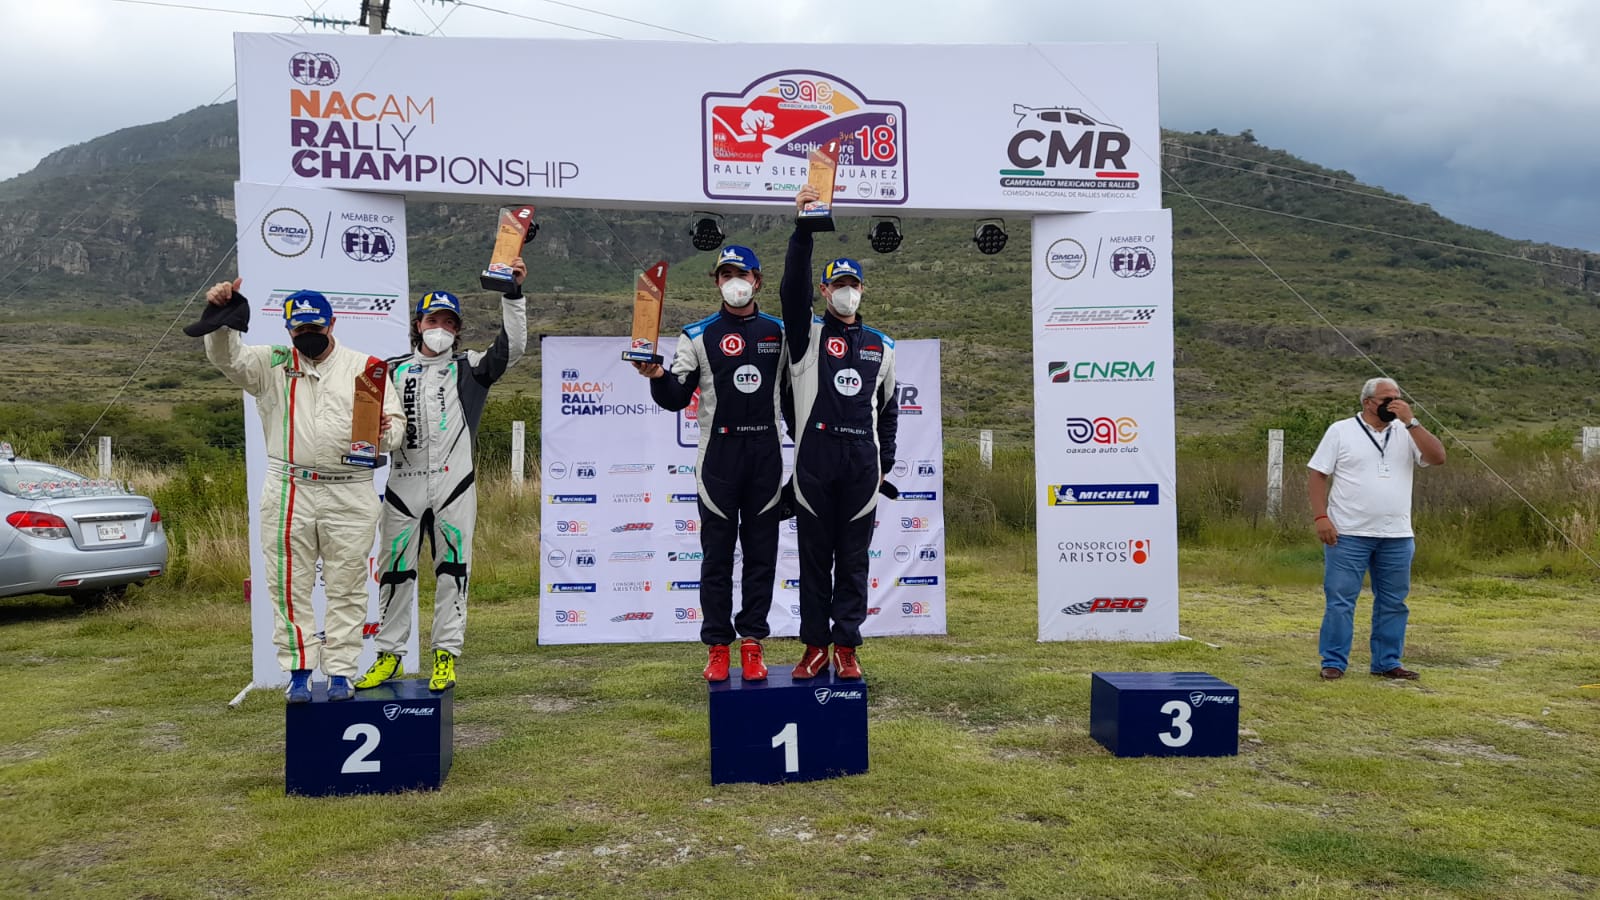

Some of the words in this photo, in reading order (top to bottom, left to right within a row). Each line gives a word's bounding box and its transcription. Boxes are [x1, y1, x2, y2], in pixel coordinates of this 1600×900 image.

[290, 88, 434, 124] NACAM
[290, 118, 416, 152] RALLY
[855, 125, 896, 161] 18
[1007, 129, 1131, 169] CMR
[292, 150, 579, 188] CHAMPIONSHIP
[713, 164, 761, 175] RALLY
[839, 168, 898, 179] JUÁREZ
[1004, 178, 1055, 187] CAMPEONATO
[1057, 180, 1096, 188] MEXICANO
[1108, 181, 1136, 189] RALLIES
[341, 213, 379, 223] MEMBER
[382, 215, 396, 223] OF
[518, 209, 531, 219] 2
[1144, 235, 1155, 243] OF
[656, 266, 664, 278] 1
[1073, 361, 1155, 379] CNRM
[736, 373, 759, 382] GTO
[837, 376, 859, 386] GTO
[562, 382, 613, 392] NACAM
[562, 394, 604, 404] RALLY
[403, 377, 417, 449] MOTHERS
[1098, 446, 1118, 454] auto
[1120, 445, 1139, 453] club
[1079, 491, 1149, 500] MICHELIN
[1057, 541, 1127, 550] CONSORCIO
[1059, 551, 1127, 562] ARISTOS
[1158, 700, 1193, 747] 3
[341, 723, 381, 774] 2
[771, 723, 799, 773] 1
